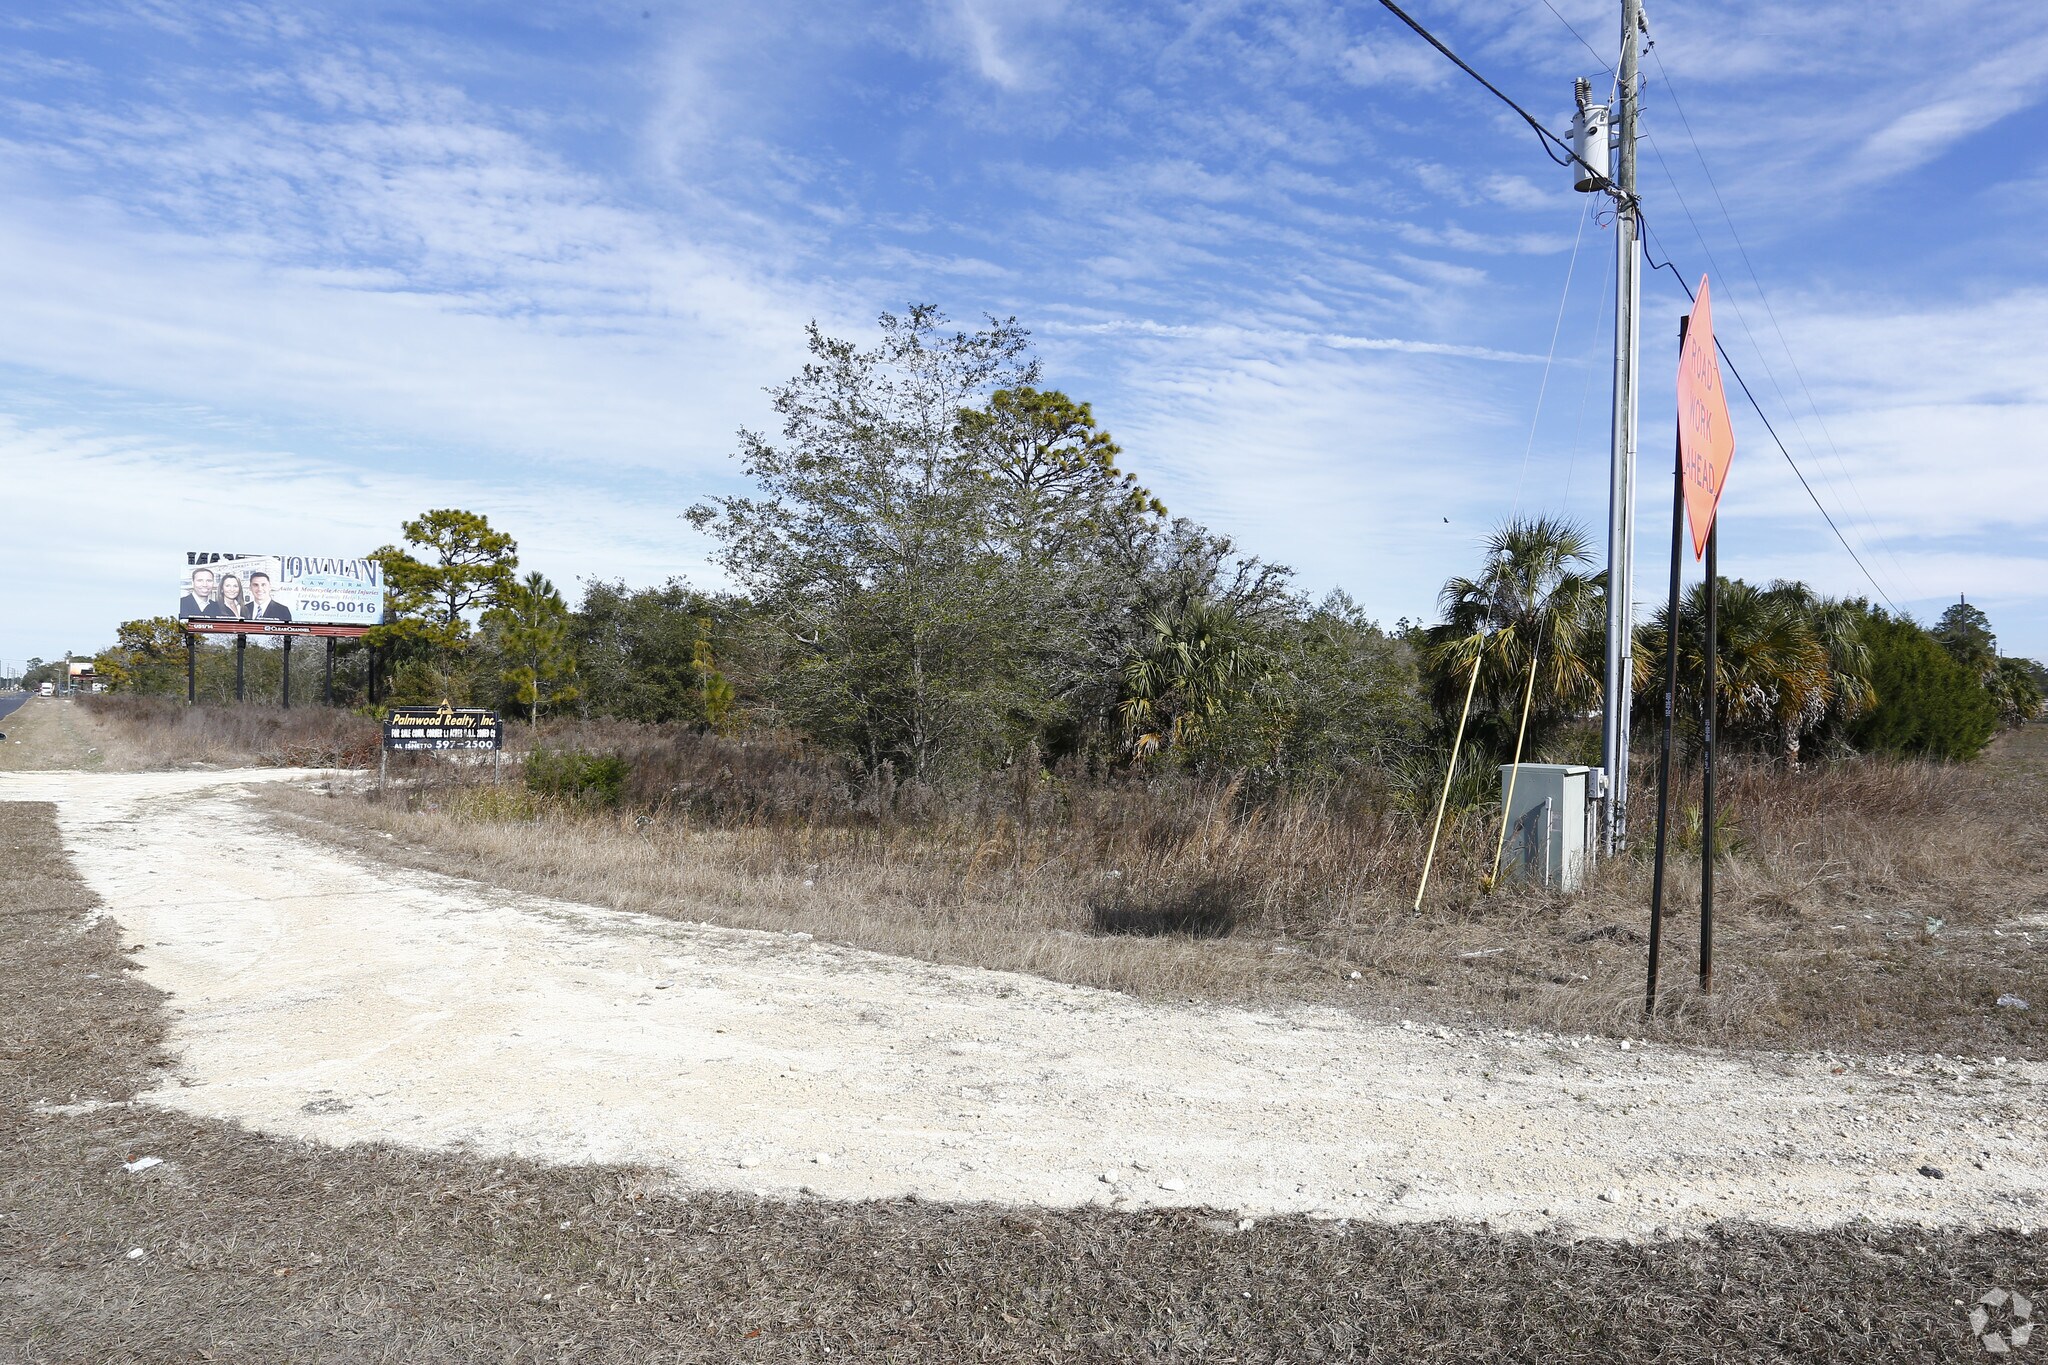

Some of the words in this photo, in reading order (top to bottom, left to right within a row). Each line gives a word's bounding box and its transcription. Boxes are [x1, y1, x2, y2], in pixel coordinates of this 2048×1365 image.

[1691, 337, 1713, 391] ROAD
[1689, 390, 1713, 444] WORK
[1685, 444, 1715, 495] AHEAD
[280, 555, 377, 587] LOWMAN
[301, 586, 332, 594] Motorcycle
[301, 600, 376, 613] 796-0016
[392, 714, 442, 726] Palmwood
[444, 714, 477, 727] Realty,
[480, 714, 496, 726] Inc.
[401, 728, 411, 738] SALE
[435, 740, 493, 749] 597-2500
